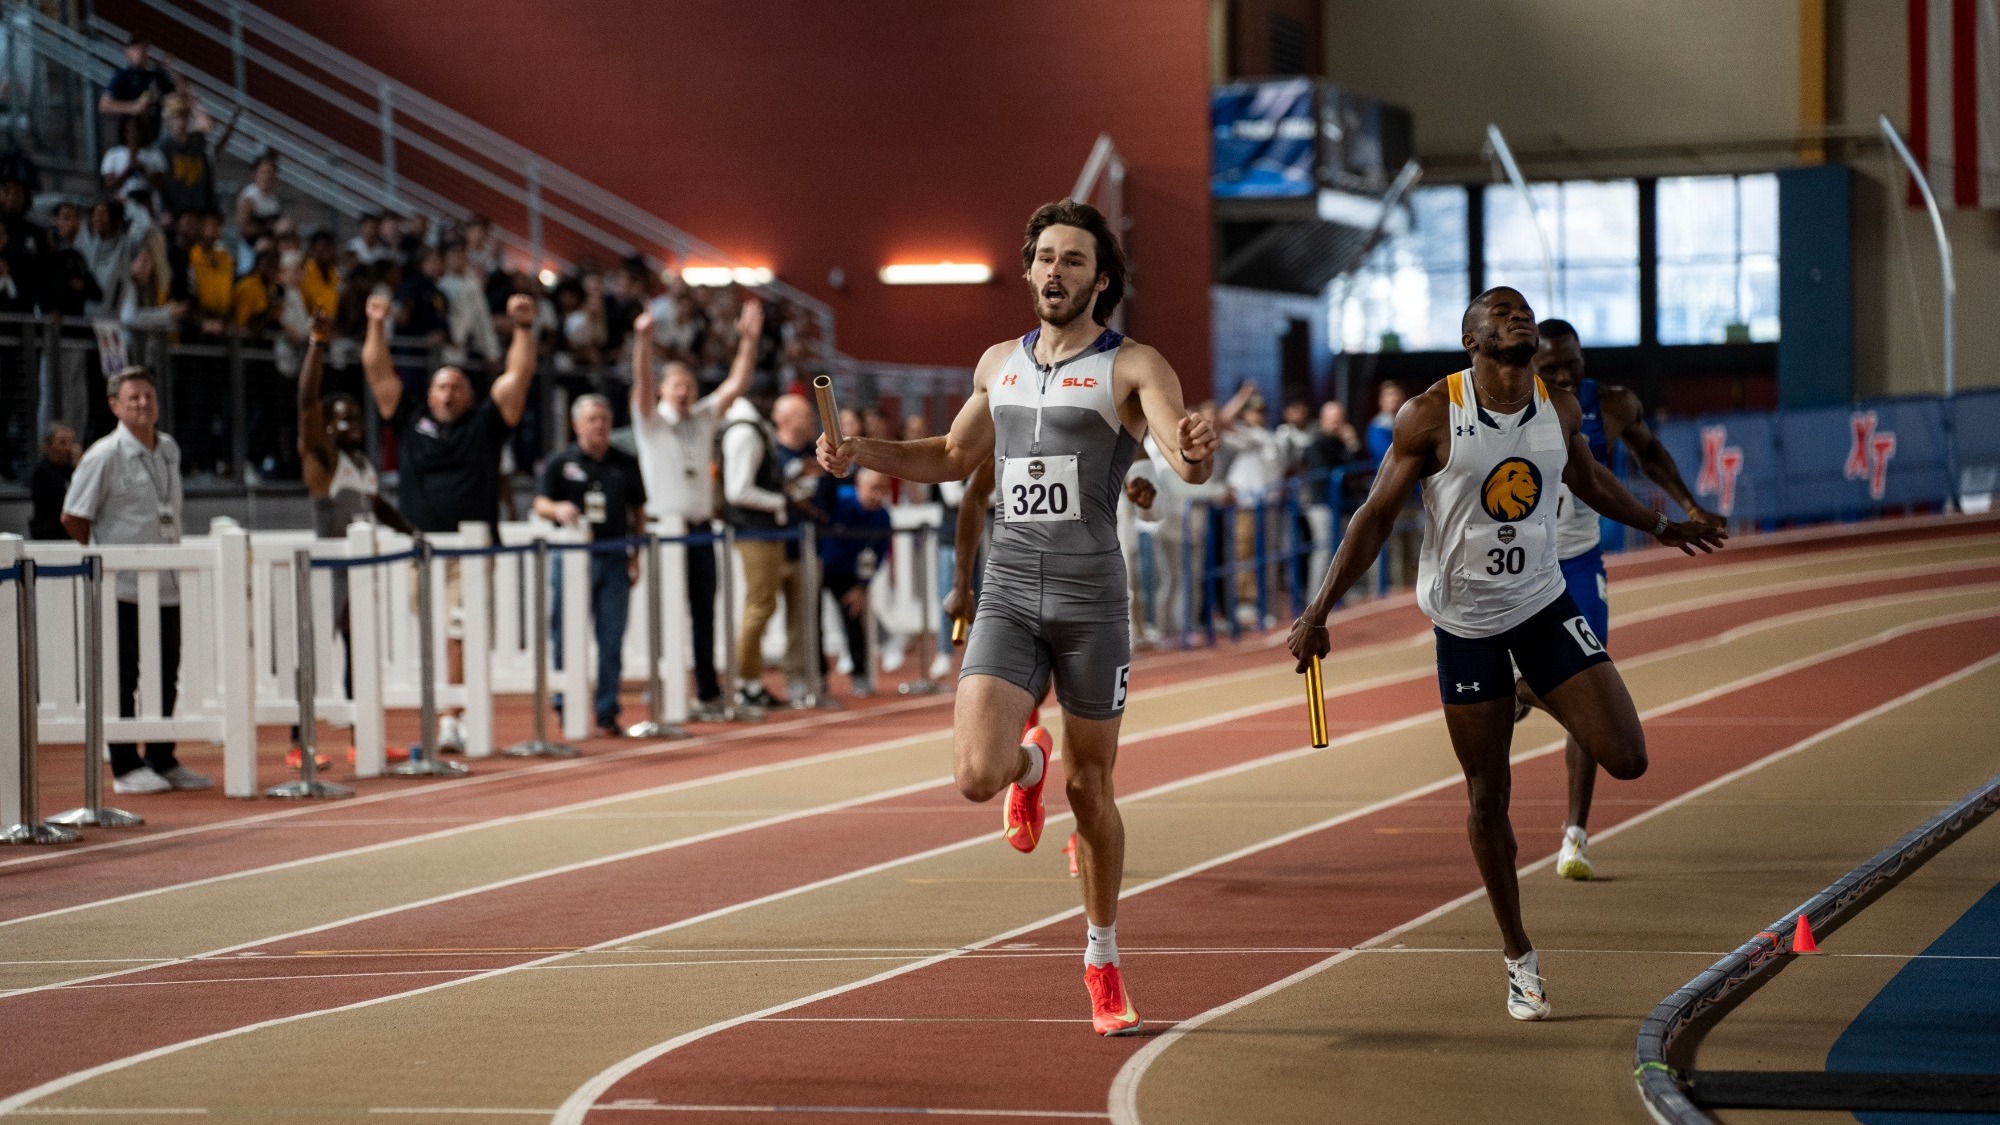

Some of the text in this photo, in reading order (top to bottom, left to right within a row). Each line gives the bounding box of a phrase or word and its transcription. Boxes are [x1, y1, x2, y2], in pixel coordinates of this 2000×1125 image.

[1012, 482, 1068, 515] 320
[1486, 546, 1525, 576] 30
[1575, 618, 1601, 651] 6
[1117, 667, 1129, 706] 5
